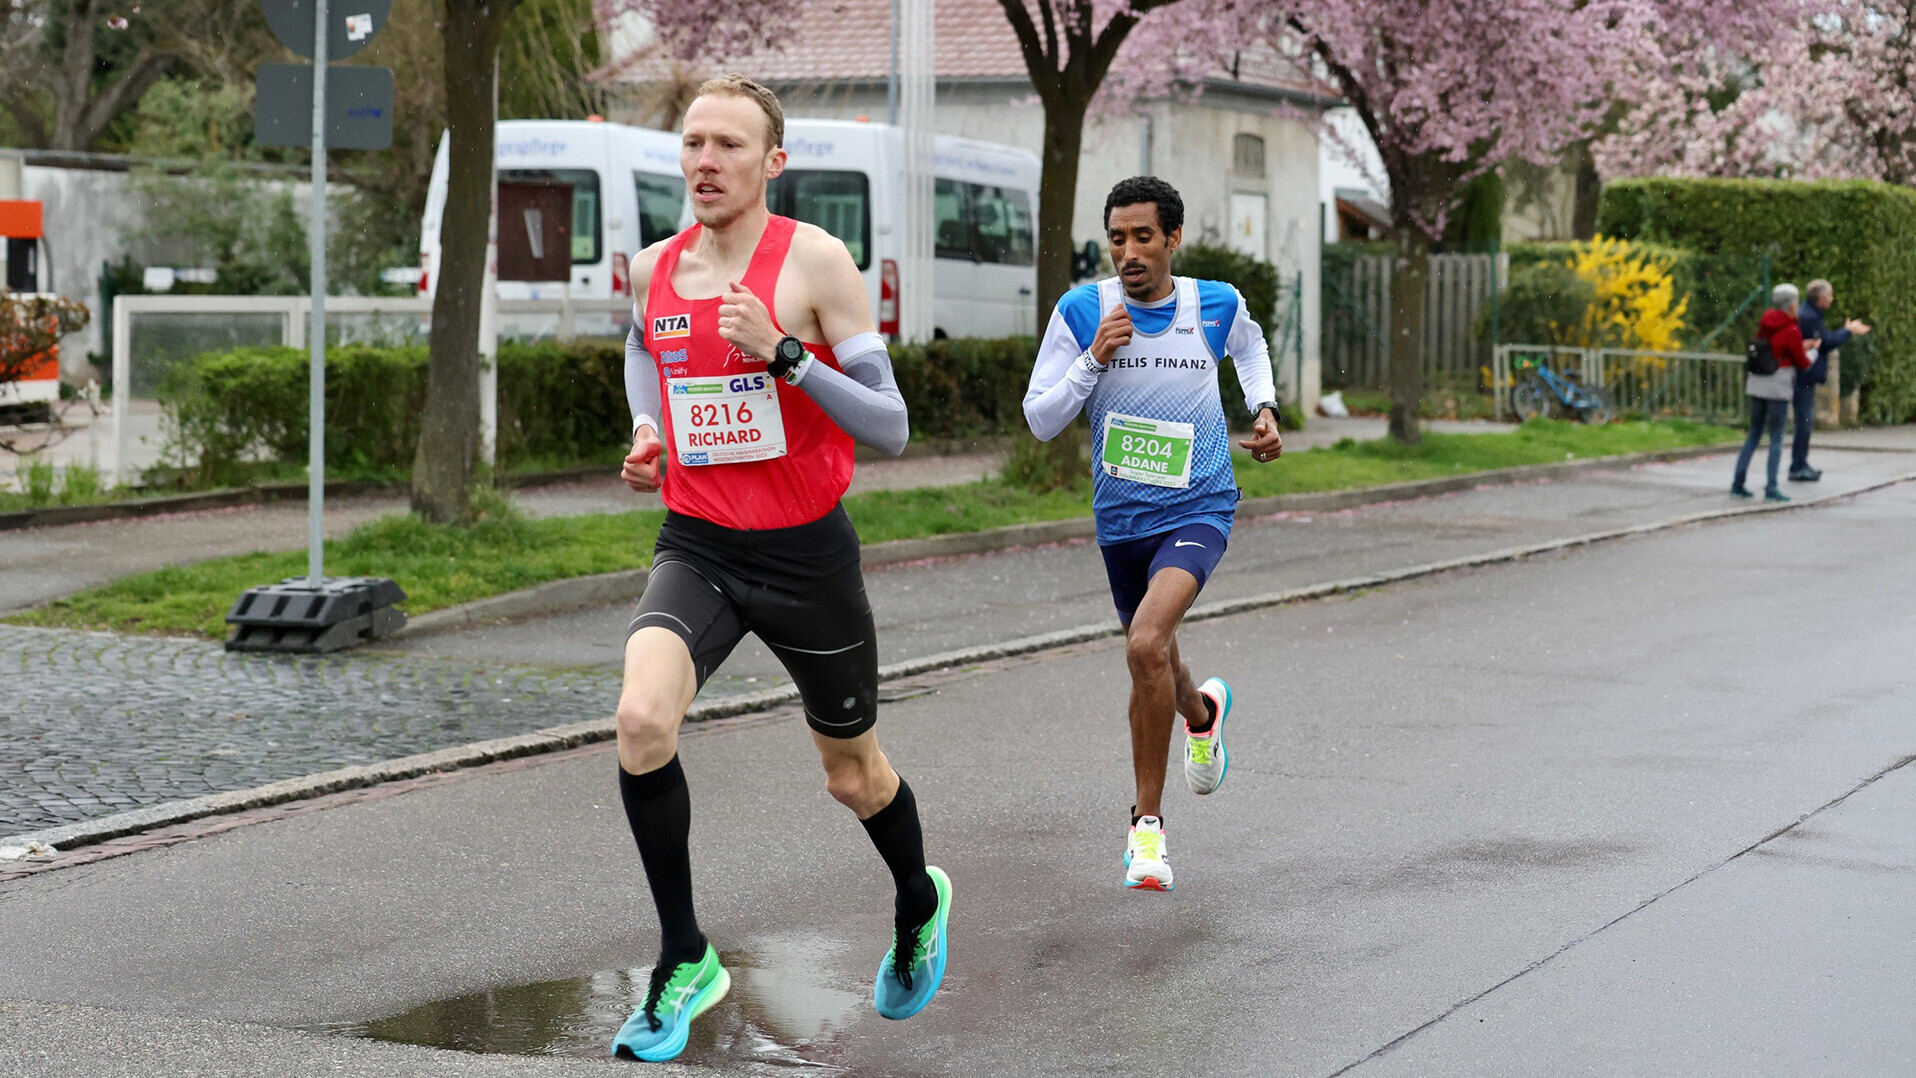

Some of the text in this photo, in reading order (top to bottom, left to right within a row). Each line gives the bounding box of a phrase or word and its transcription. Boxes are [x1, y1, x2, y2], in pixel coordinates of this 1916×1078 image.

[655, 316, 688, 332] NTA
[1111, 357, 1147, 369] TELIS
[1155, 358, 1207, 369] FINANZ
[729, 376, 765, 393] GLS
[690, 401, 753, 427] 8216
[688, 429, 762, 447] RICHARD
[1121, 435, 1172, 458] 8204
[1121, 455, 1168, 473] ADANE
